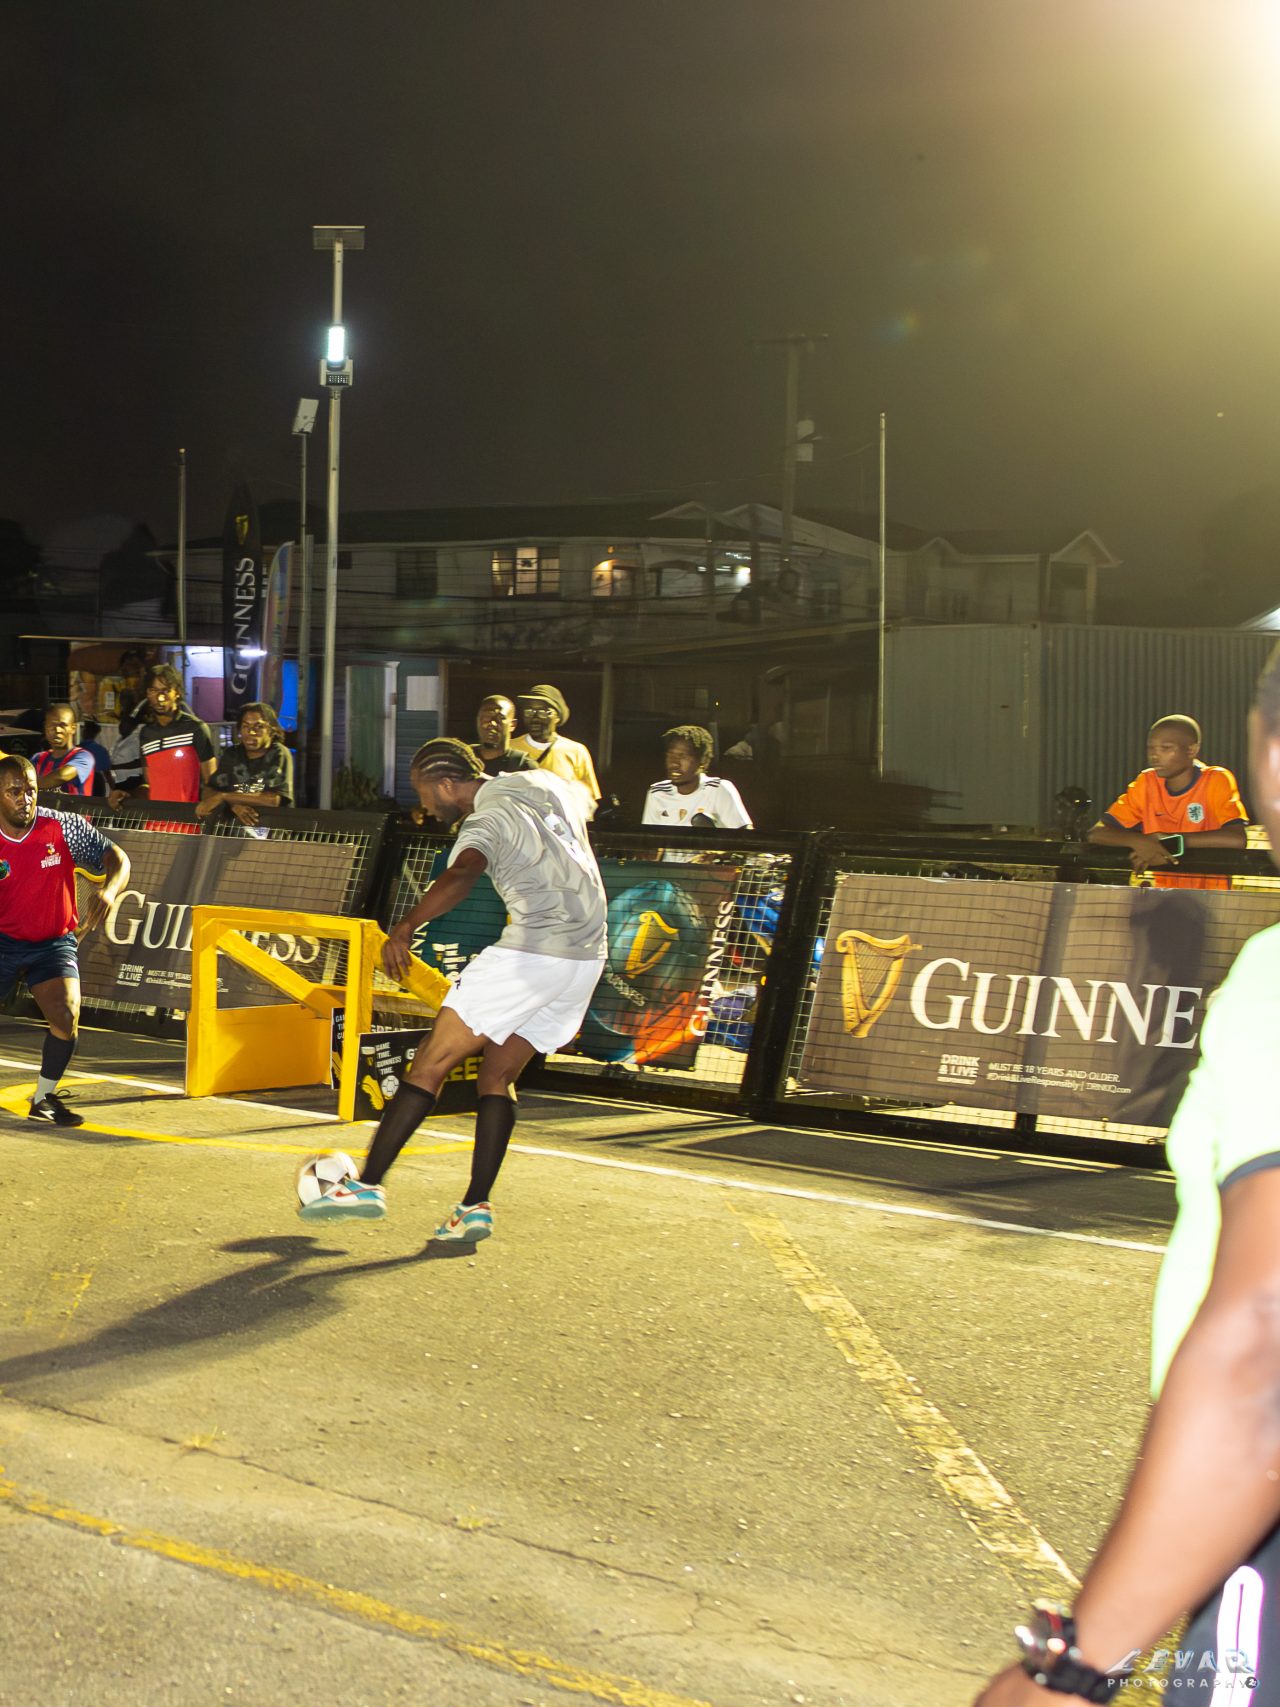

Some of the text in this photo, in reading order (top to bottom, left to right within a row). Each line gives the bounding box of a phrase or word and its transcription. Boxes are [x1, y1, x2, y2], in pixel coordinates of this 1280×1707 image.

[231, 557, 256, 694] GUINNESS
[120, 963, 144, 973] DRINK
[689, 901, 734, 1036] GUINNESS
[125, 973, 143, 981] LIVE
[909, 957, 1203, 1049] GUINNE
[941, 1054, 980, 1067] DRINK
[938, 1064, 979, 1078] & LIVE
[988, 1062, 1120, 1083] MUST BE 18 YEARS AND OLDER.
